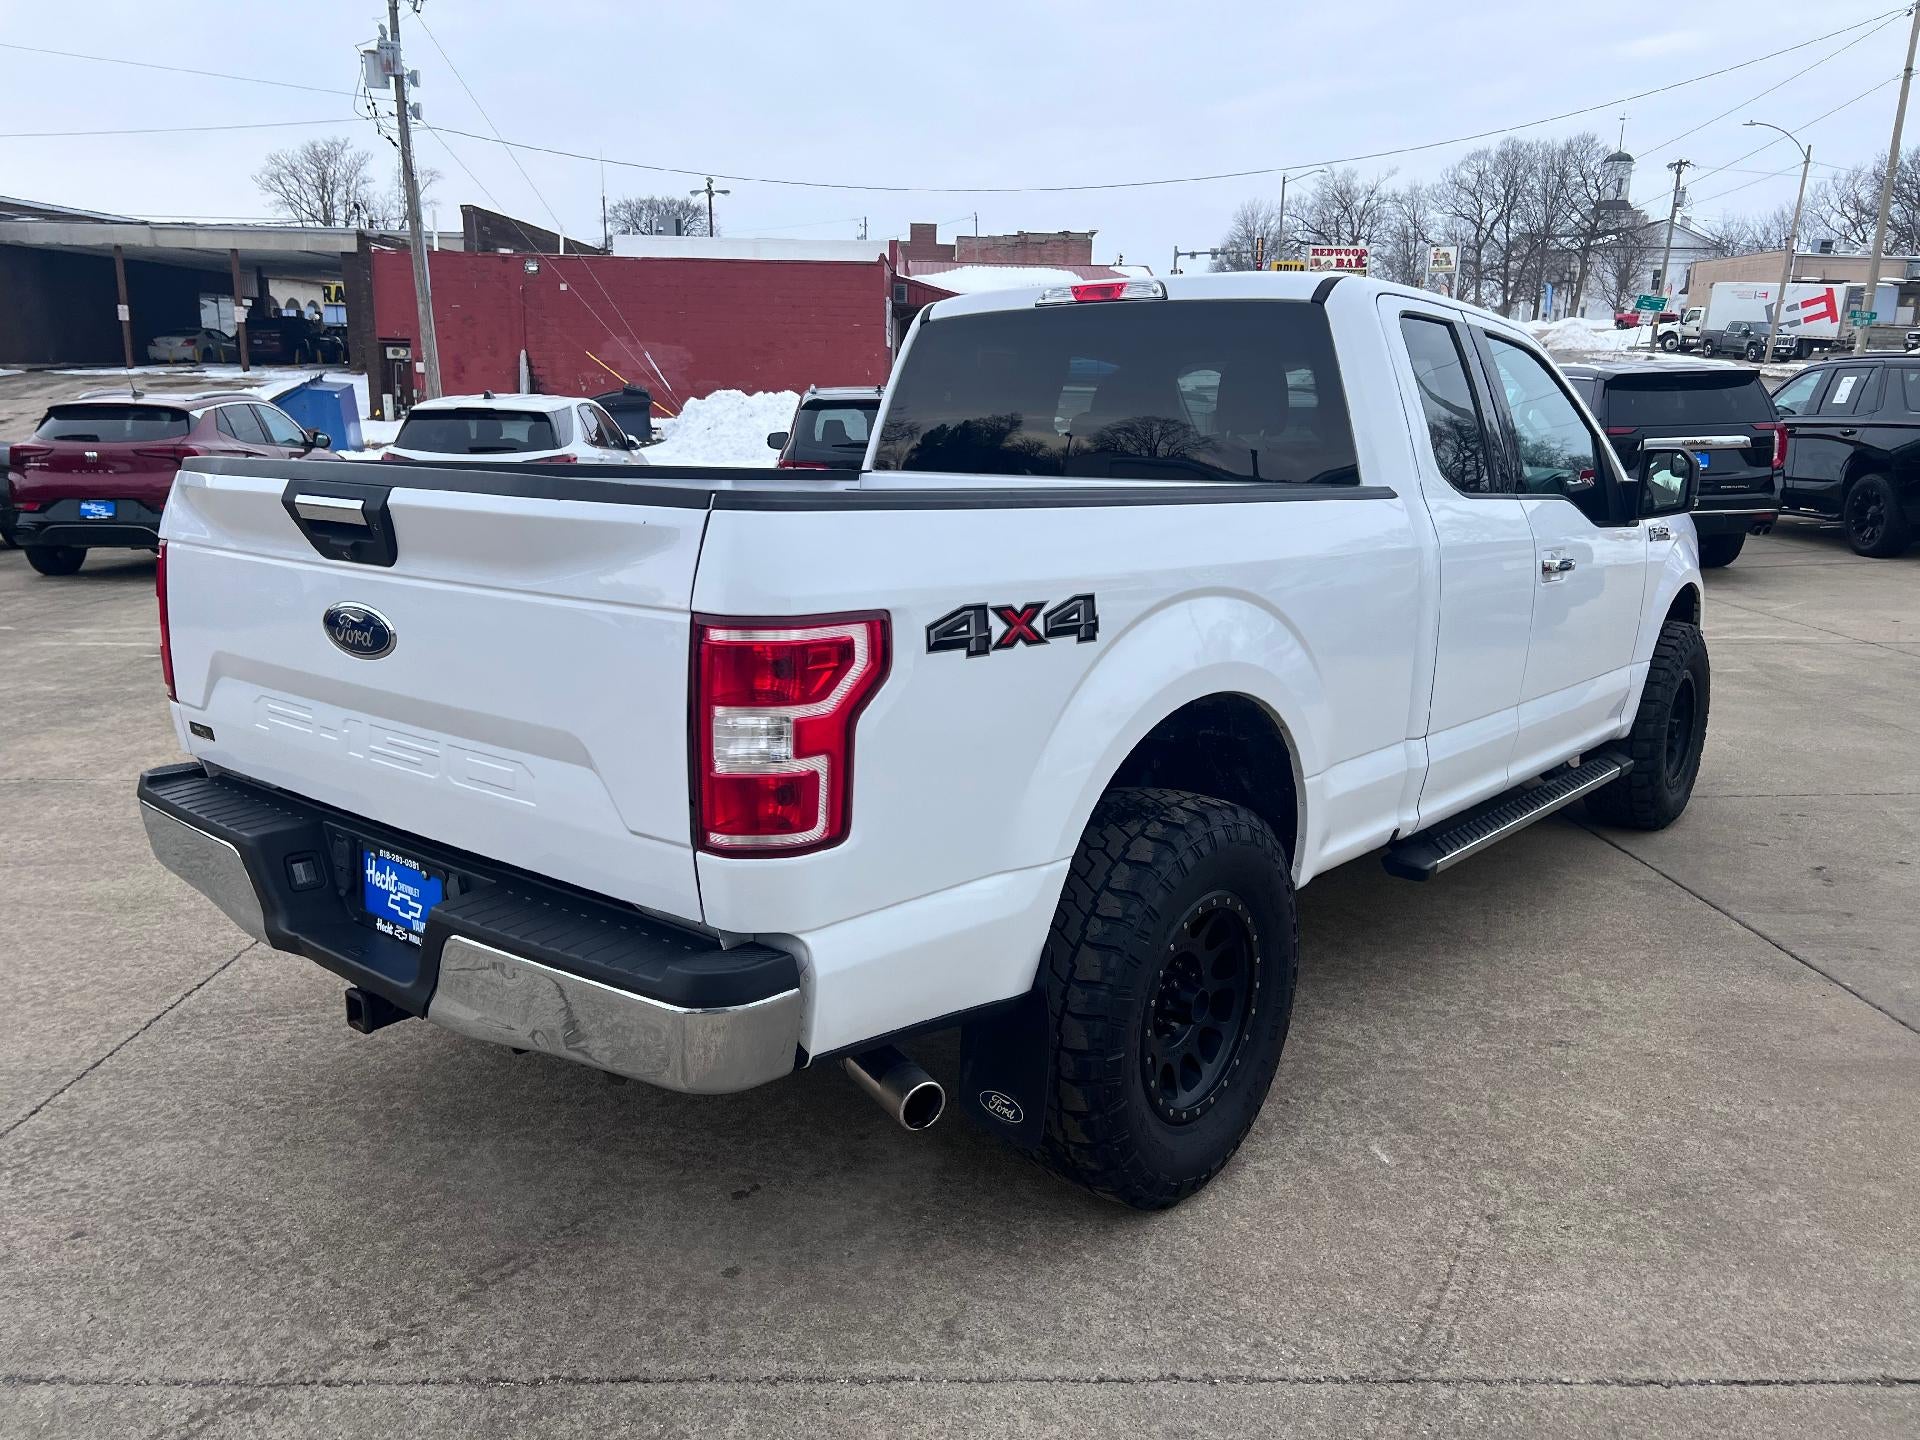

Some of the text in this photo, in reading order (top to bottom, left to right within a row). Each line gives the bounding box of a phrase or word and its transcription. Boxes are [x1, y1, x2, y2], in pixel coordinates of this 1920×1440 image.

[1311, 248, 1368, 257] REDWOOD
[1335, 258, 1367, 268] BAR
[335, 612, 374, 647] Ford
[254, 695, 537, 807] F-150
[365, 857, 399, 894] Hecht
[988, 1094, 1015, 1120] Ford
